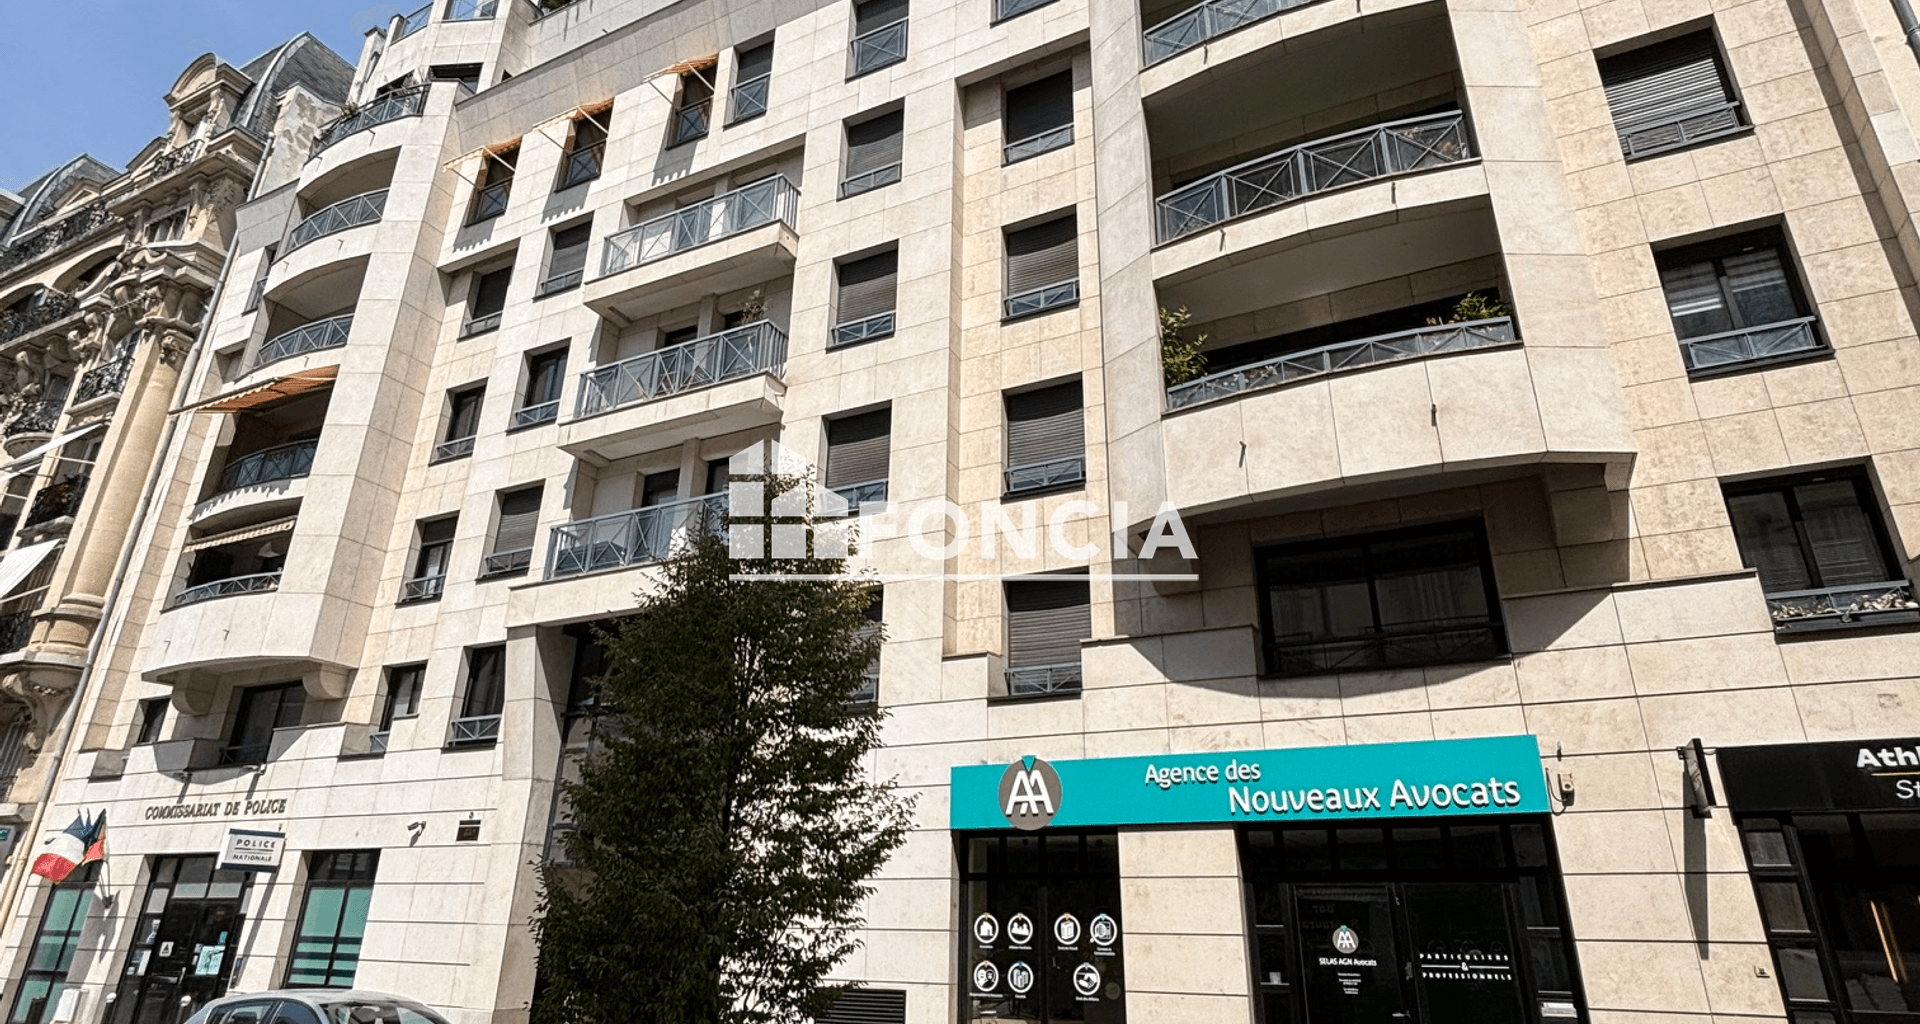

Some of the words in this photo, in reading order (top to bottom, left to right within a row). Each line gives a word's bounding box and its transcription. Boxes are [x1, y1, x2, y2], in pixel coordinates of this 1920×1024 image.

[1145, 763, 1219, 788] Agence
[1225, 763, 1261, 781] des
[1228, 786, 1381, 813] Nouveaux
[1389, 777, 1521, 808] Avocats
[145, 802, 221, 820] COMMISSARIAT
[224, 801, 241, 816] DE
[244, 798, 288, 815] POLICE
[236, 838, 276, 848] POLICE
[232, 854, 272, 862] NATIONALE
[1318, 957, 1338, 966] SELAS
[1353, 958, 1378, 967] Avocats
[1419, 953, 1509, 961] PARTICULIERS
[1422, 972, 1512, 981] PROFESSIONNELS
